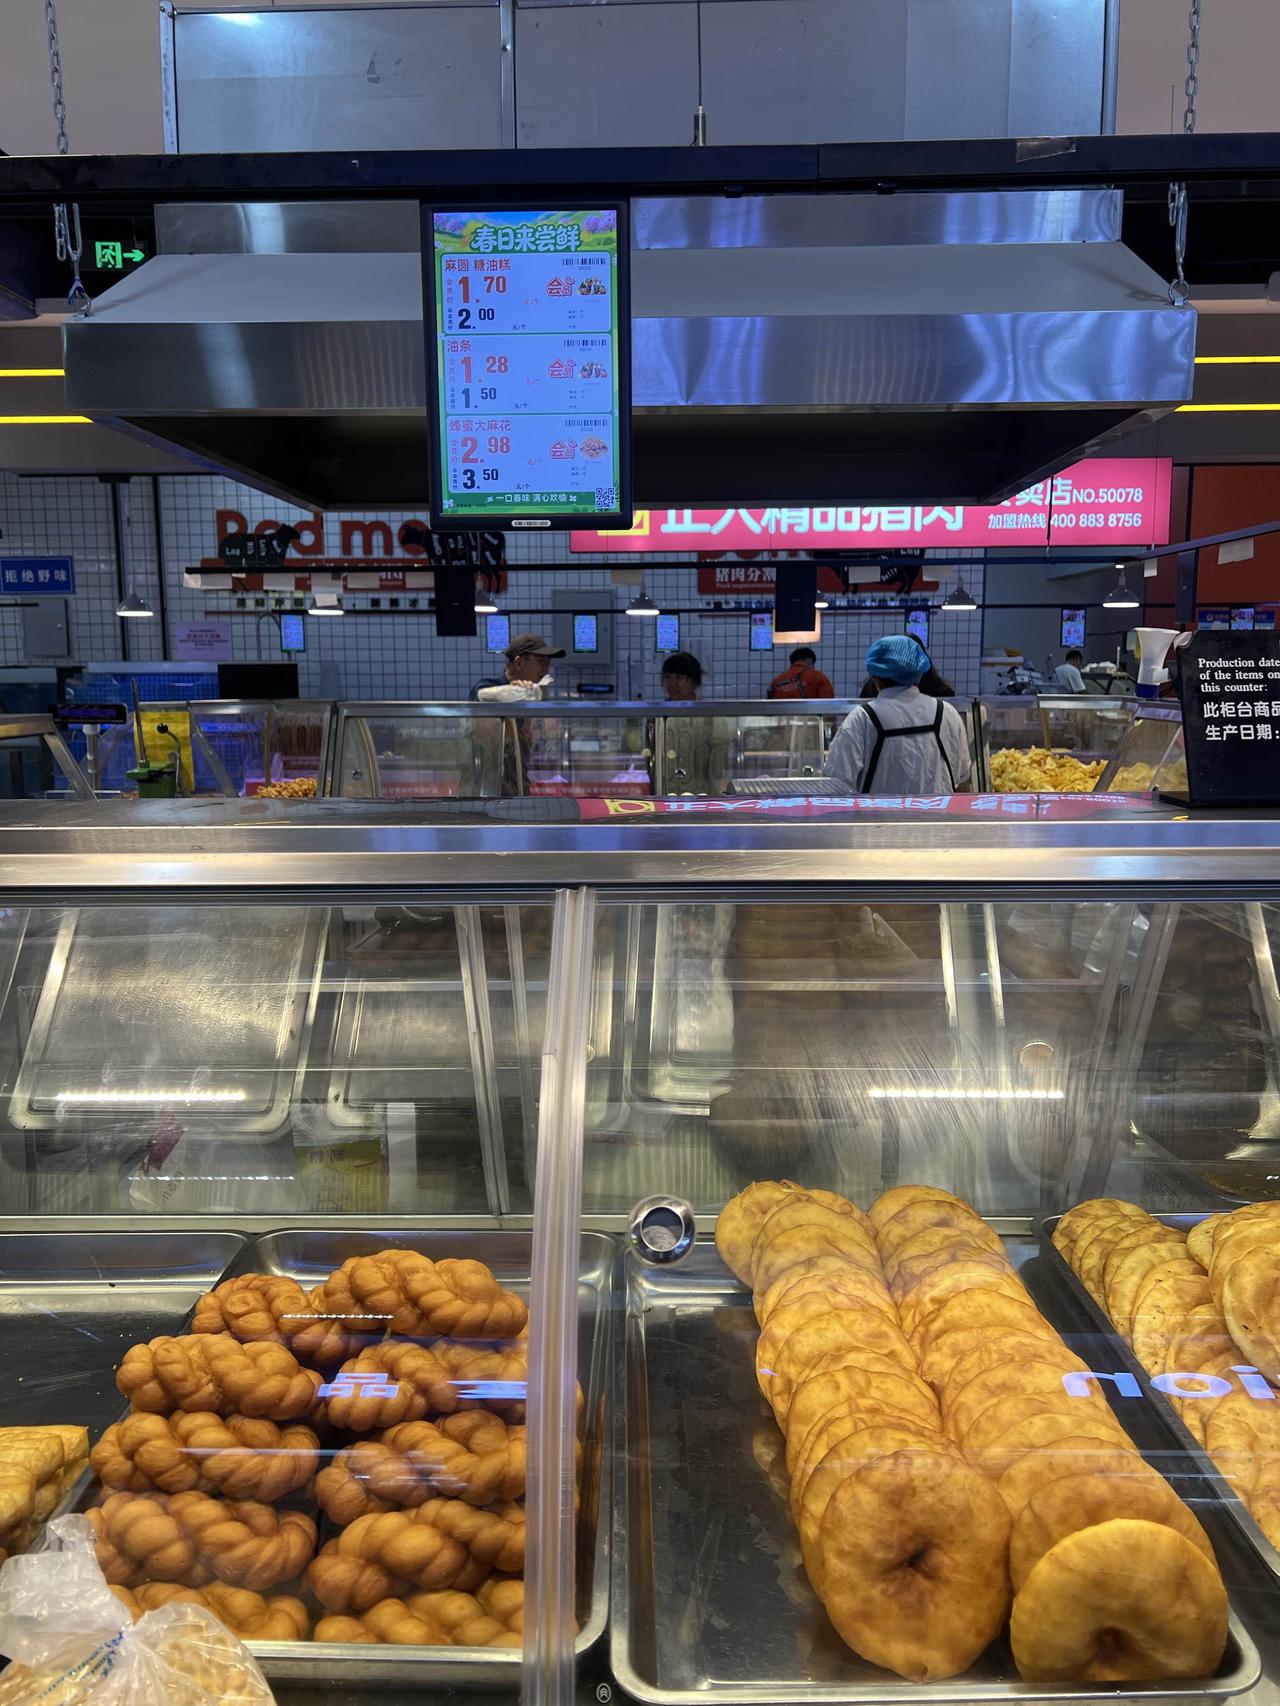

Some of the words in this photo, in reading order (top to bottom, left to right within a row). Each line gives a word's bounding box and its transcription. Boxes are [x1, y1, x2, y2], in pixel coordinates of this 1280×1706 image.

[472, 224, 580, 252] 春日来尝鲜
[445, 259, 469, 272] 麻圆
[474, 258, 510, 271] 糖油糕
[547, 276, 575, 297] 会员
[447, 340, 471, 352] 油条
[450, 419, 511, 432] 蜂蜜大麻花
[1000, 477, 1073, 507] 卖店
[1073, 488, 1143, 504] NO.50078
[988, 513, 1047, 529] 加盟热线
[1050, 514, 1076, 527] 400
[1079, 514, 1104, 527] 883
[1108, 513, 1142, 527] 8756
[5, 569, 68, 583] 拒绝野味
[1198, 658, 1255, 668] Production
[1200, 670, 1211, 680] of
[1215, 670, 1231, 680] the
[1235, 670, 1264, 680] items
[1267, 671, 1280, 679] on
[1200, 683, 1220, 692] this
[1224, 683, 1268, 692] counter:
[1203, 701, 1280, 718] 此柜台商品
